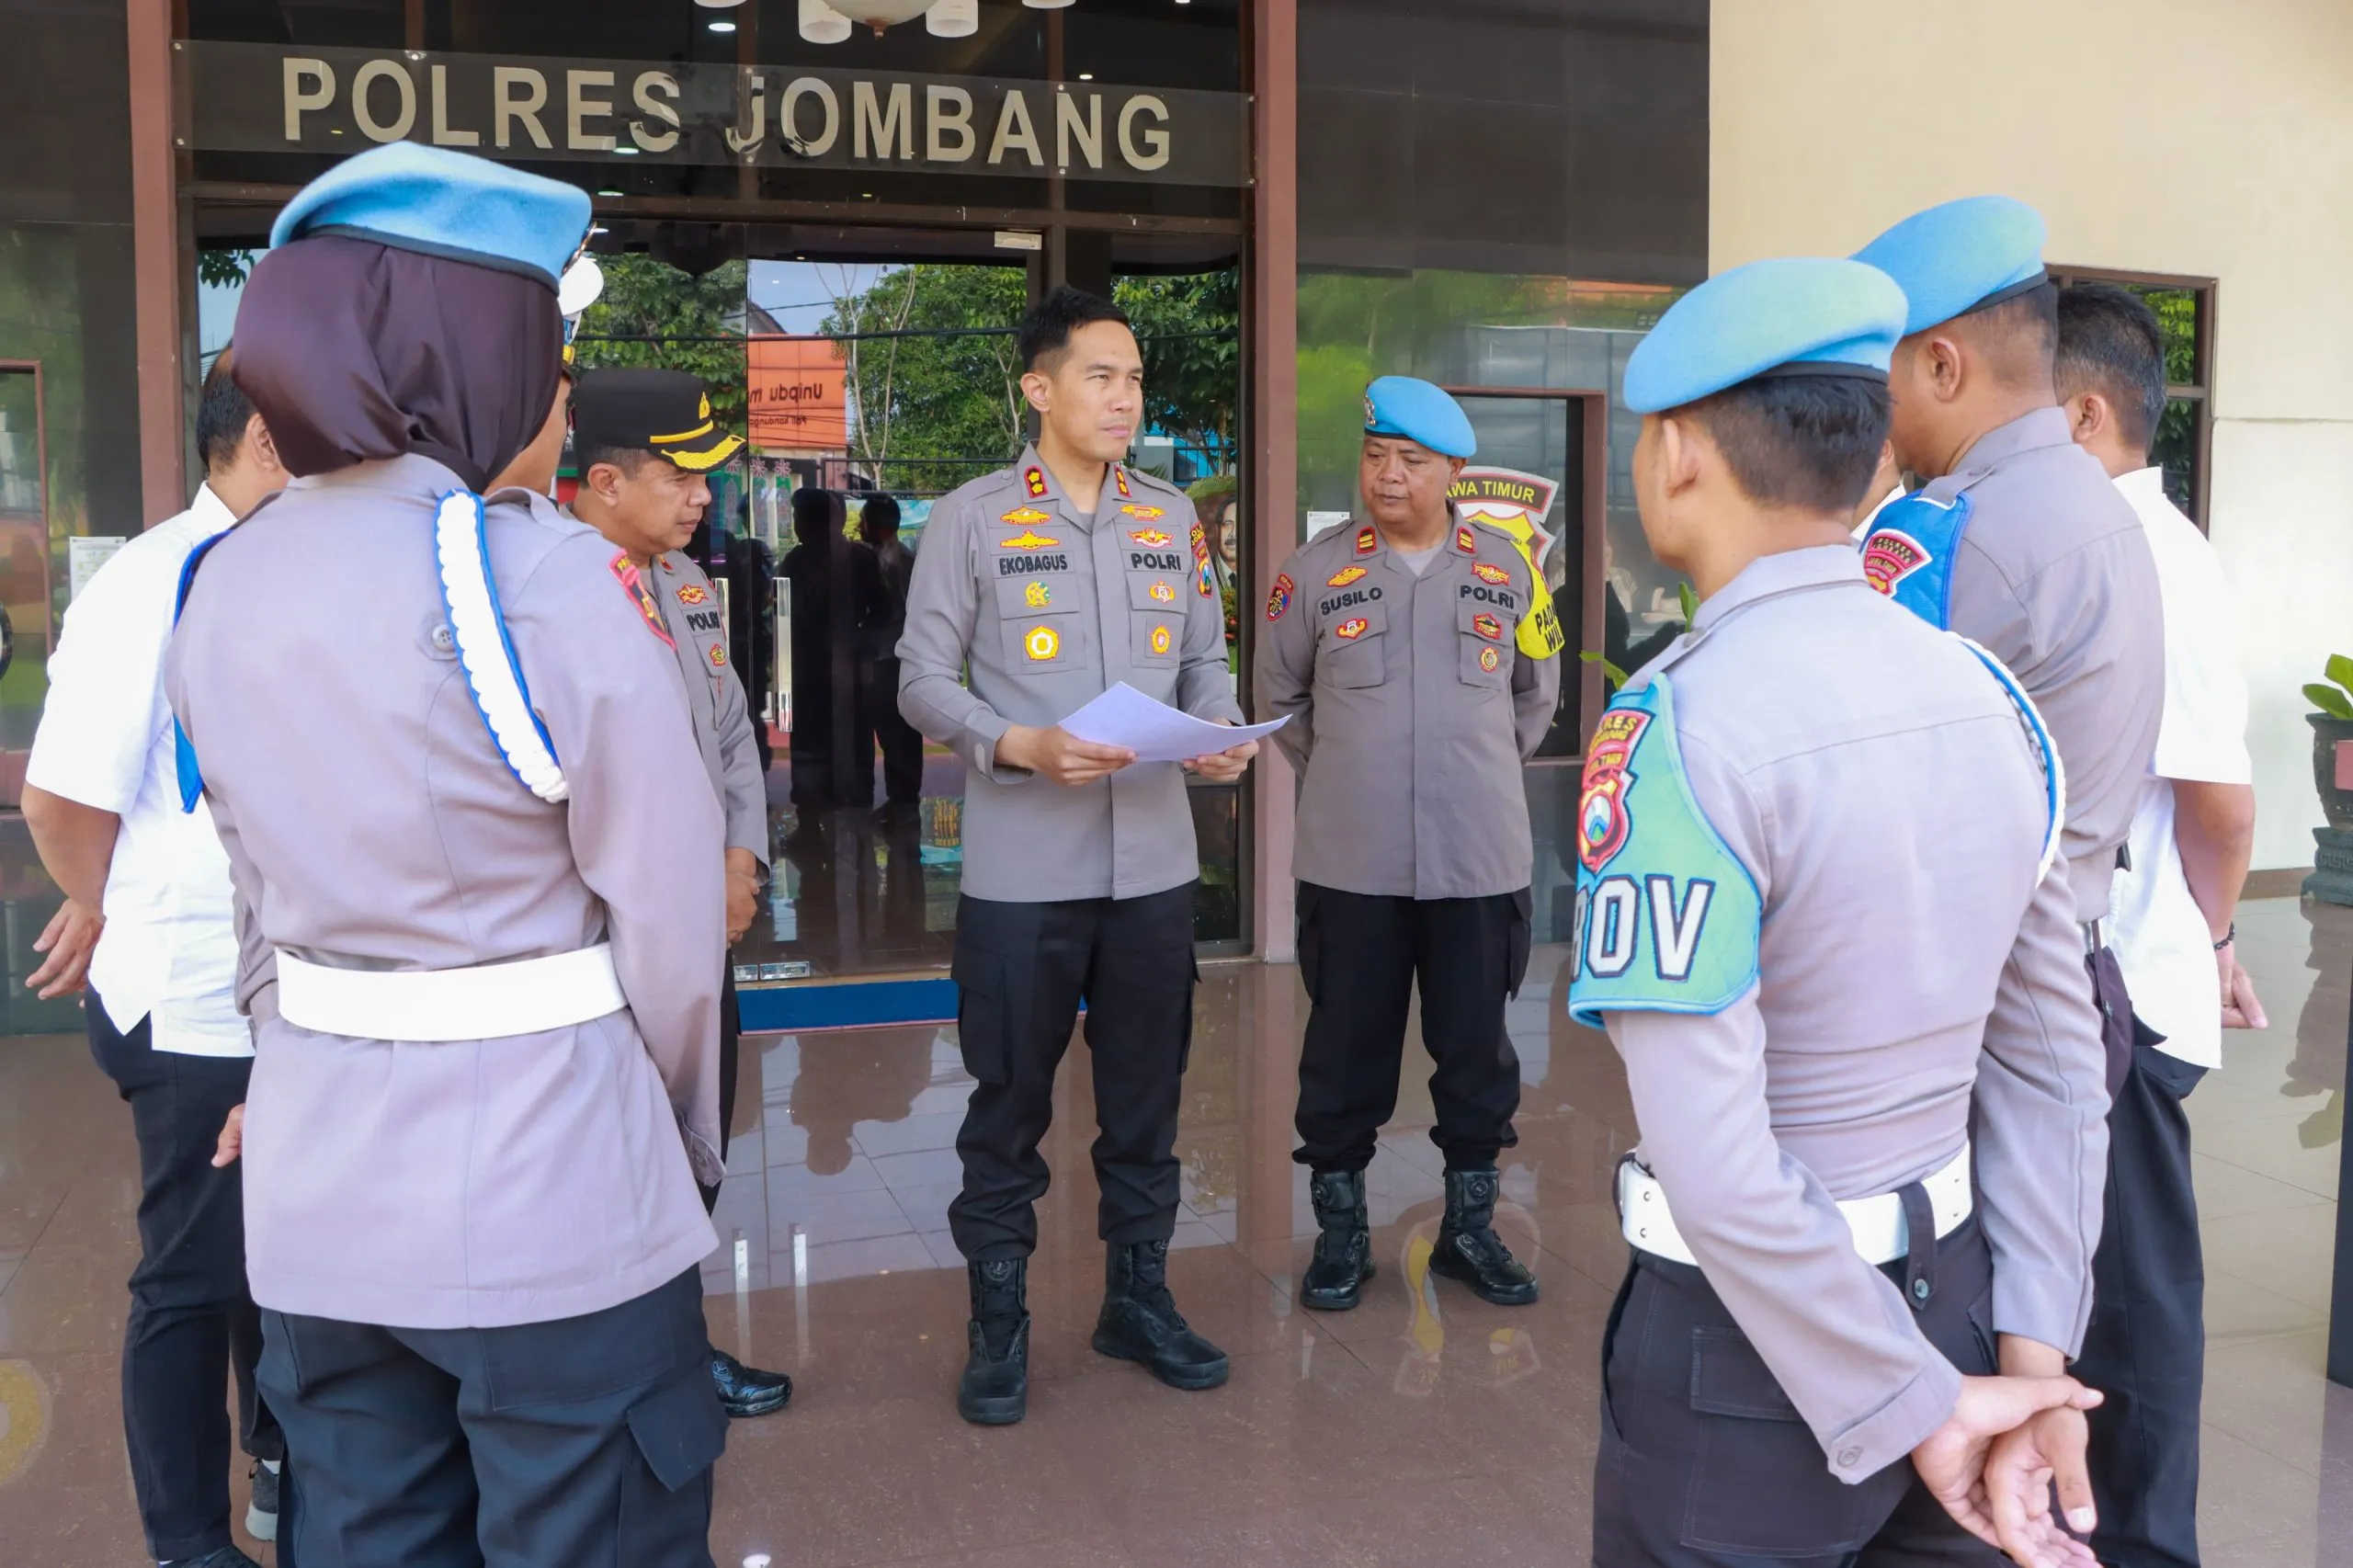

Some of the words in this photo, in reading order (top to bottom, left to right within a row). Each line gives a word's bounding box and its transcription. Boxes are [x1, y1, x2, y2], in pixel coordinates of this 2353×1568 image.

[283, 57, 681, 153] POLRES
[725, 75, 1171, 172] JOMBANG
[1482, 480, 1535, 504] TIMUR
[998, 552, 1068, 575] EKOBAGUS
[1131, 552, 1182, 572] POLRI
[1320, 585, 1383, 616] SUSILO
[1460, 584, 1515, 609] POLRI
[1600, 714, 1638, 733] RES
[1571, 873, 1716, 983] ROV
